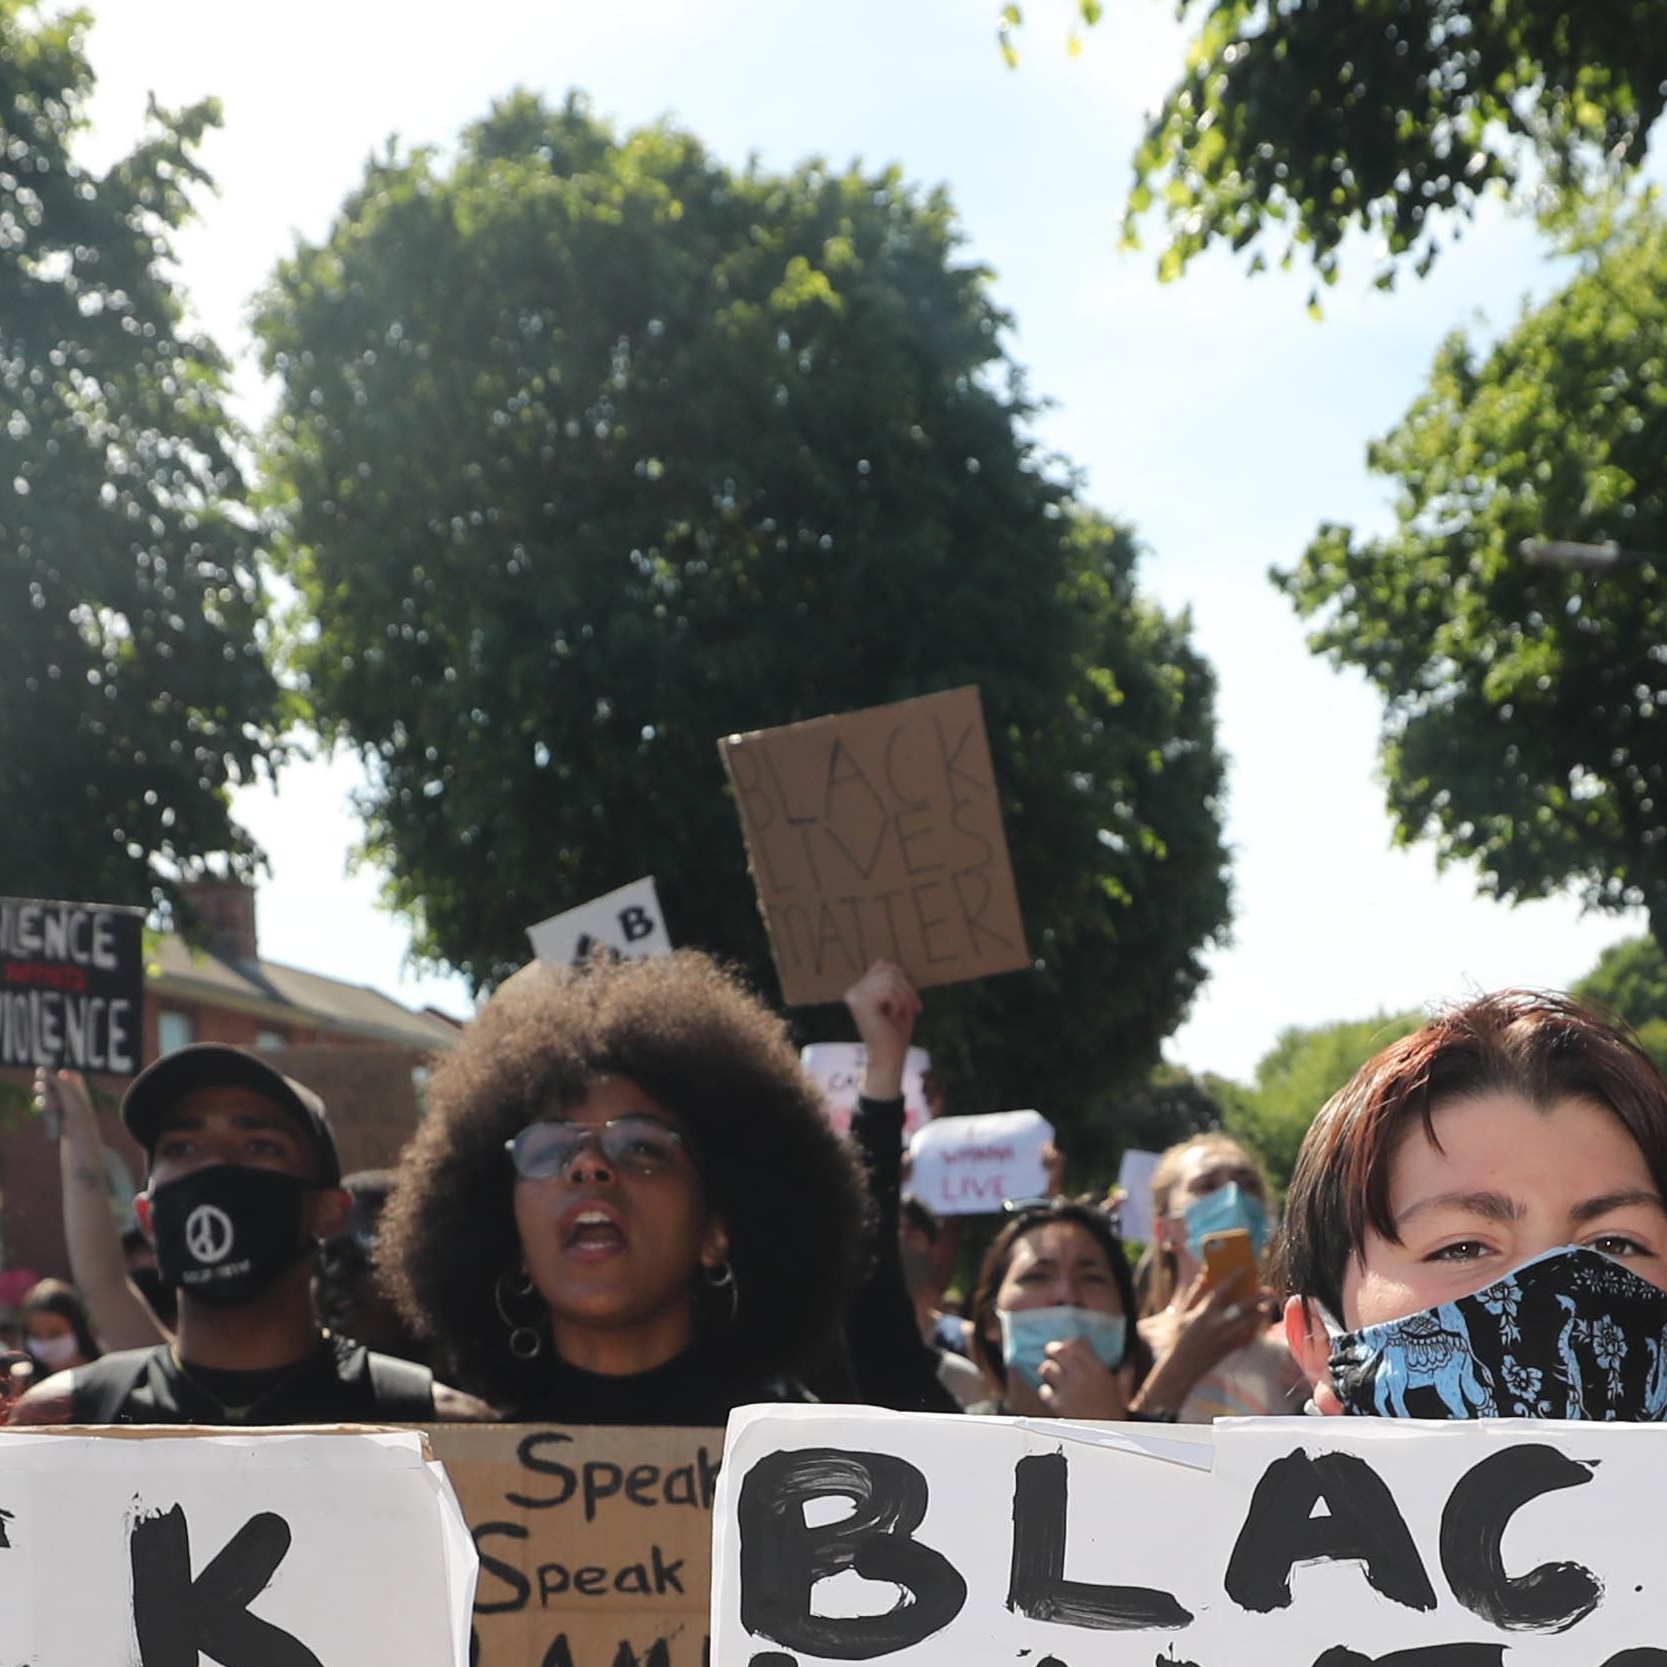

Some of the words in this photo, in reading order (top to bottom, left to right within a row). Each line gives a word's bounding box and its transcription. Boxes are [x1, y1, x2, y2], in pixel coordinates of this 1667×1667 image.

[724, 712, 988, 832] BLACK
[758, 799, 994, 894] LIVES
[767, 868, 1019, 975] MATTER
[940, 1174, 1009, 1202] LIVE
